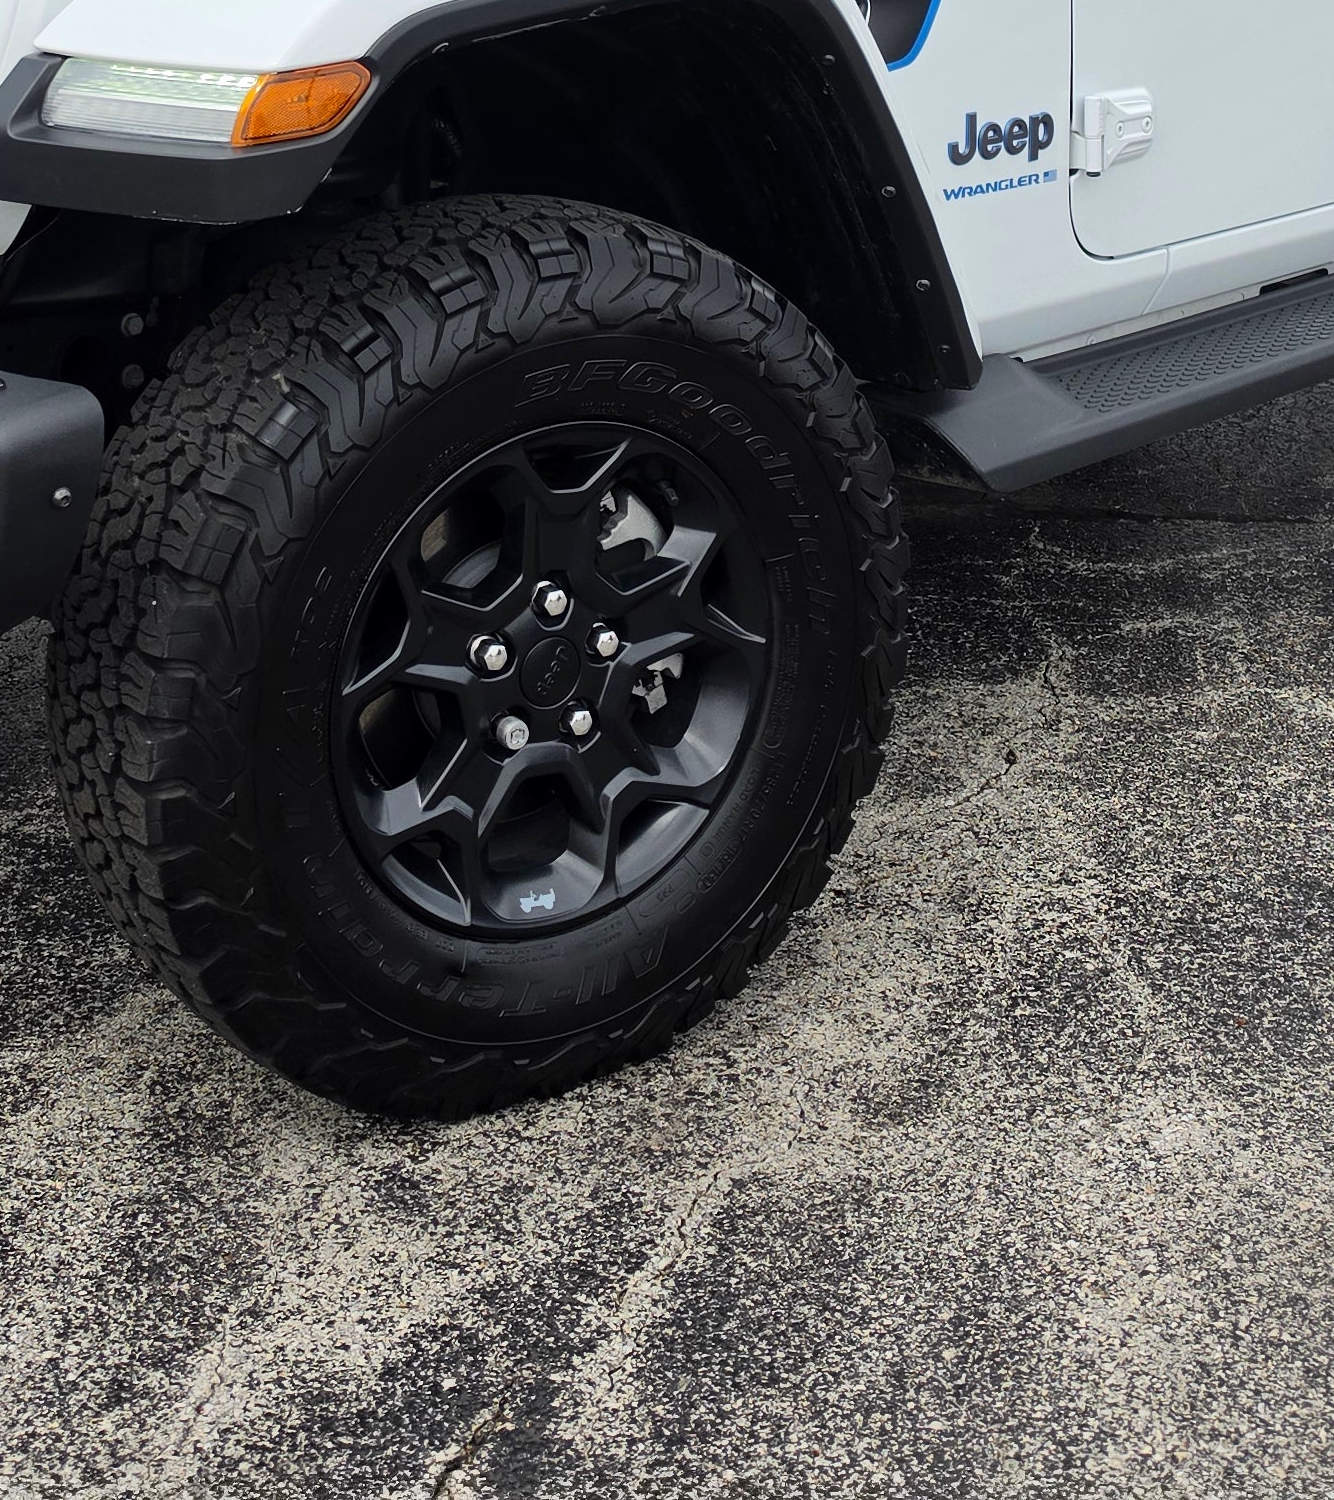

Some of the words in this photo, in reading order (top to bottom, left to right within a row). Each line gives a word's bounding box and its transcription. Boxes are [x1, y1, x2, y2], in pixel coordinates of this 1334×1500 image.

[948, 111, 1055, 166] Jeep
[943, 173, 1041, 201] WRANGLER
[514, 358, 838, 636] BFGoodrich
